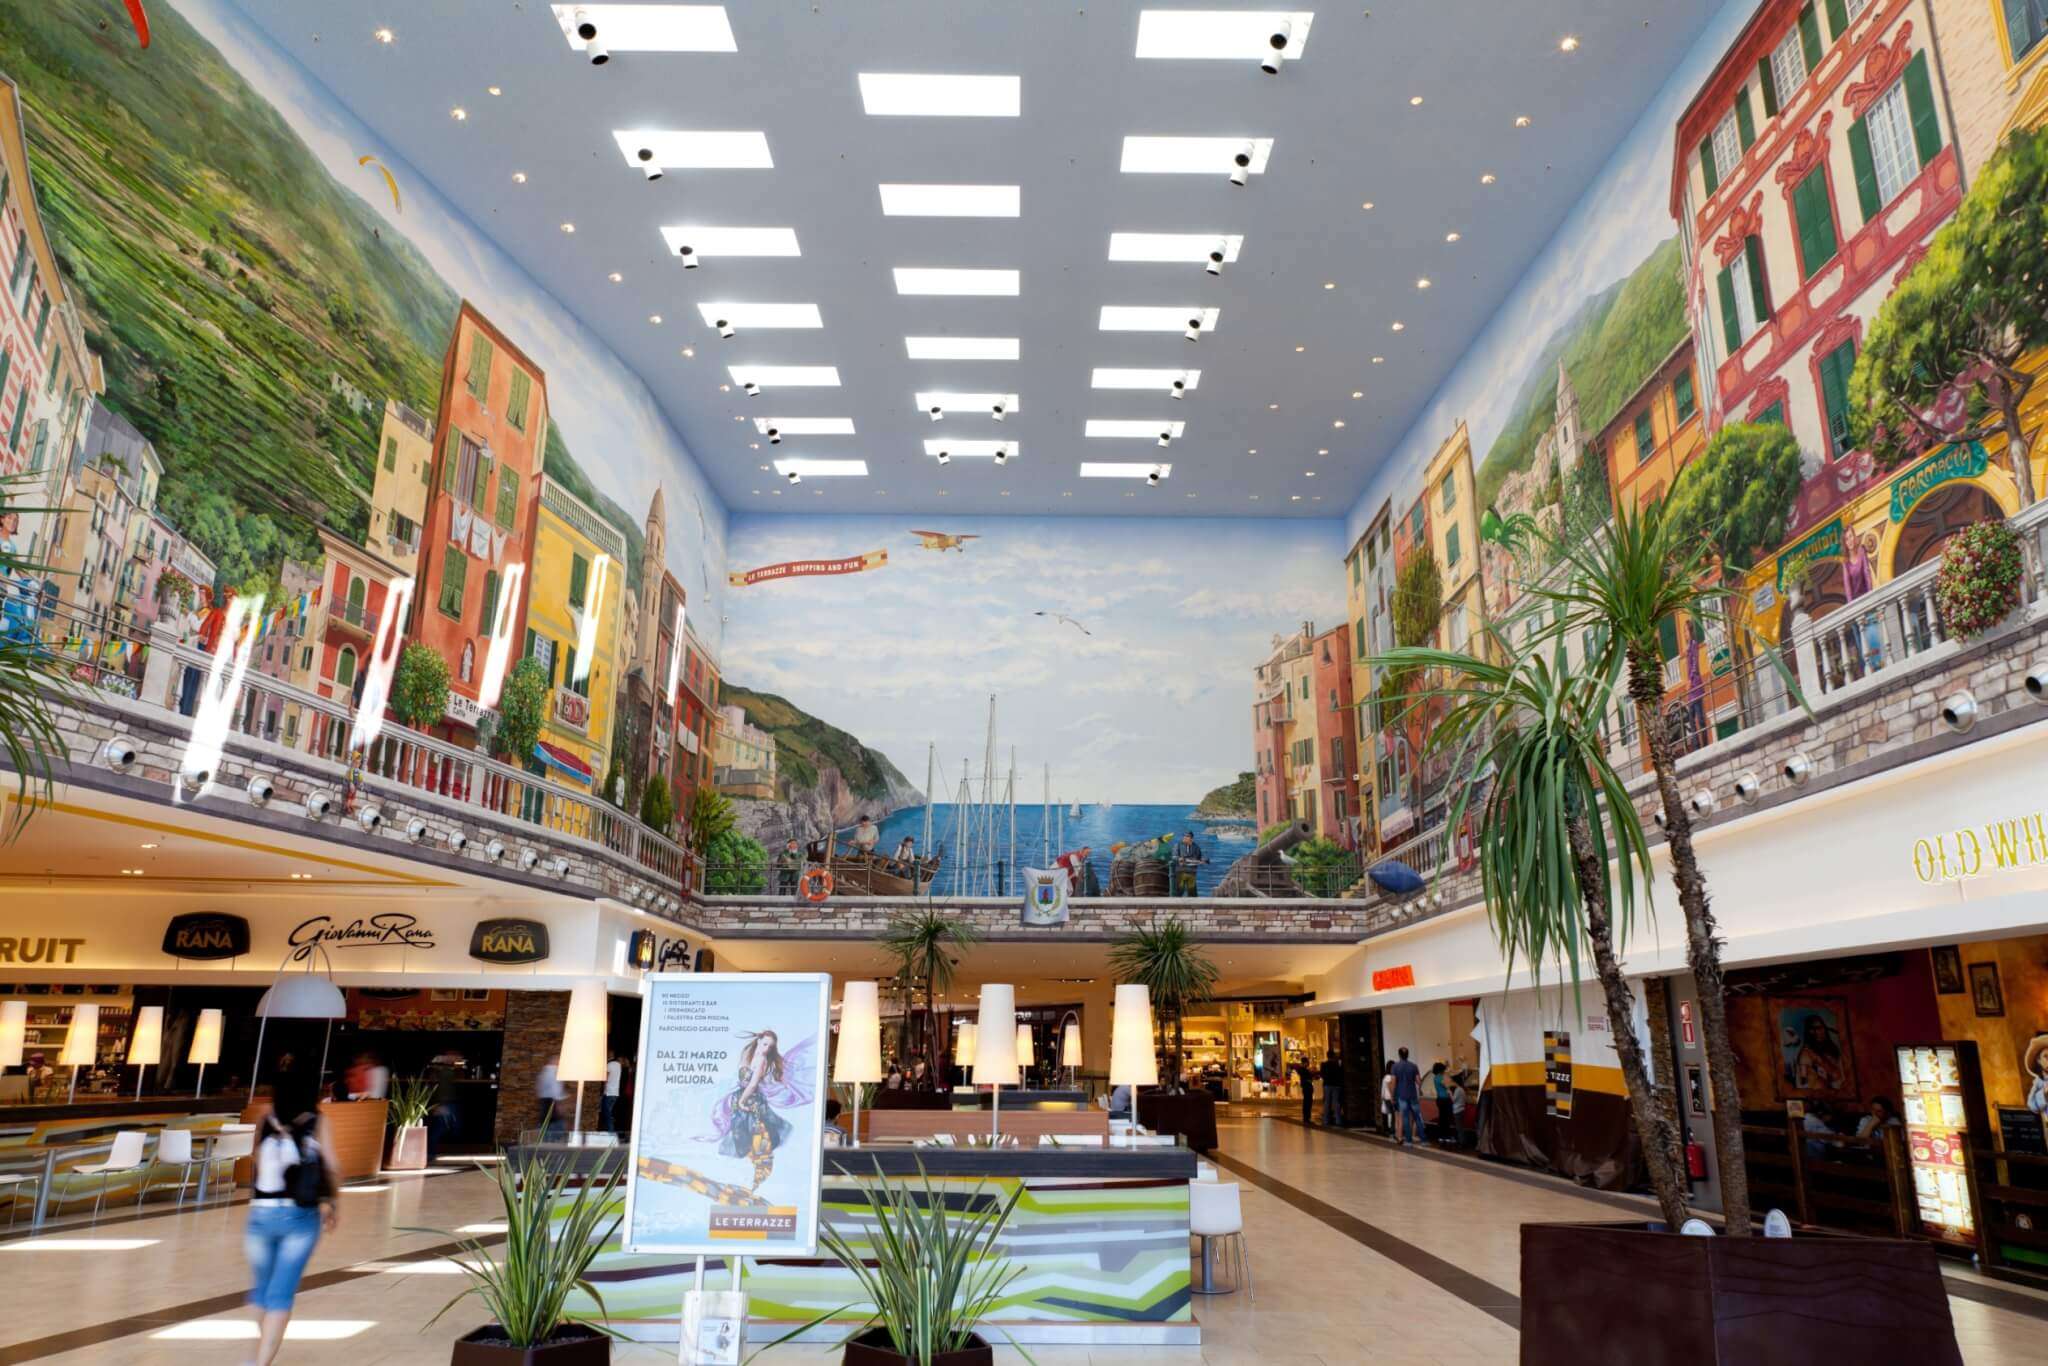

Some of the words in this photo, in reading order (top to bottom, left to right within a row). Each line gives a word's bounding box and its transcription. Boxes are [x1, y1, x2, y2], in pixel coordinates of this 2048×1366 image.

[792, 564, 825, 573] SHOPPING
[827, 563, 842, 571] AND
[843, 561, 859, 569] FUN
[1913, 830, 1981, 882] OLD
[371, 913, 436, 949] Rana
[176, 930, 233, 949] RANA
[481, 935, 536, 954] RANA
[656, 1050, 675, 1059] DAL
[679, 1051, 688, 1059] 21
[690, 1051, 728, 1060] MARZO
[663, 1063, 674, 1072] LA
[677, 1063, 695, 1072] TUA
[697, 1063, 719, 1072] VITA
[665, 1075, 714, 1084] MIGLIORA
[715, 1217, 729, 1227] LE
[732, 1217, 792, 1228] TERRAZZE
